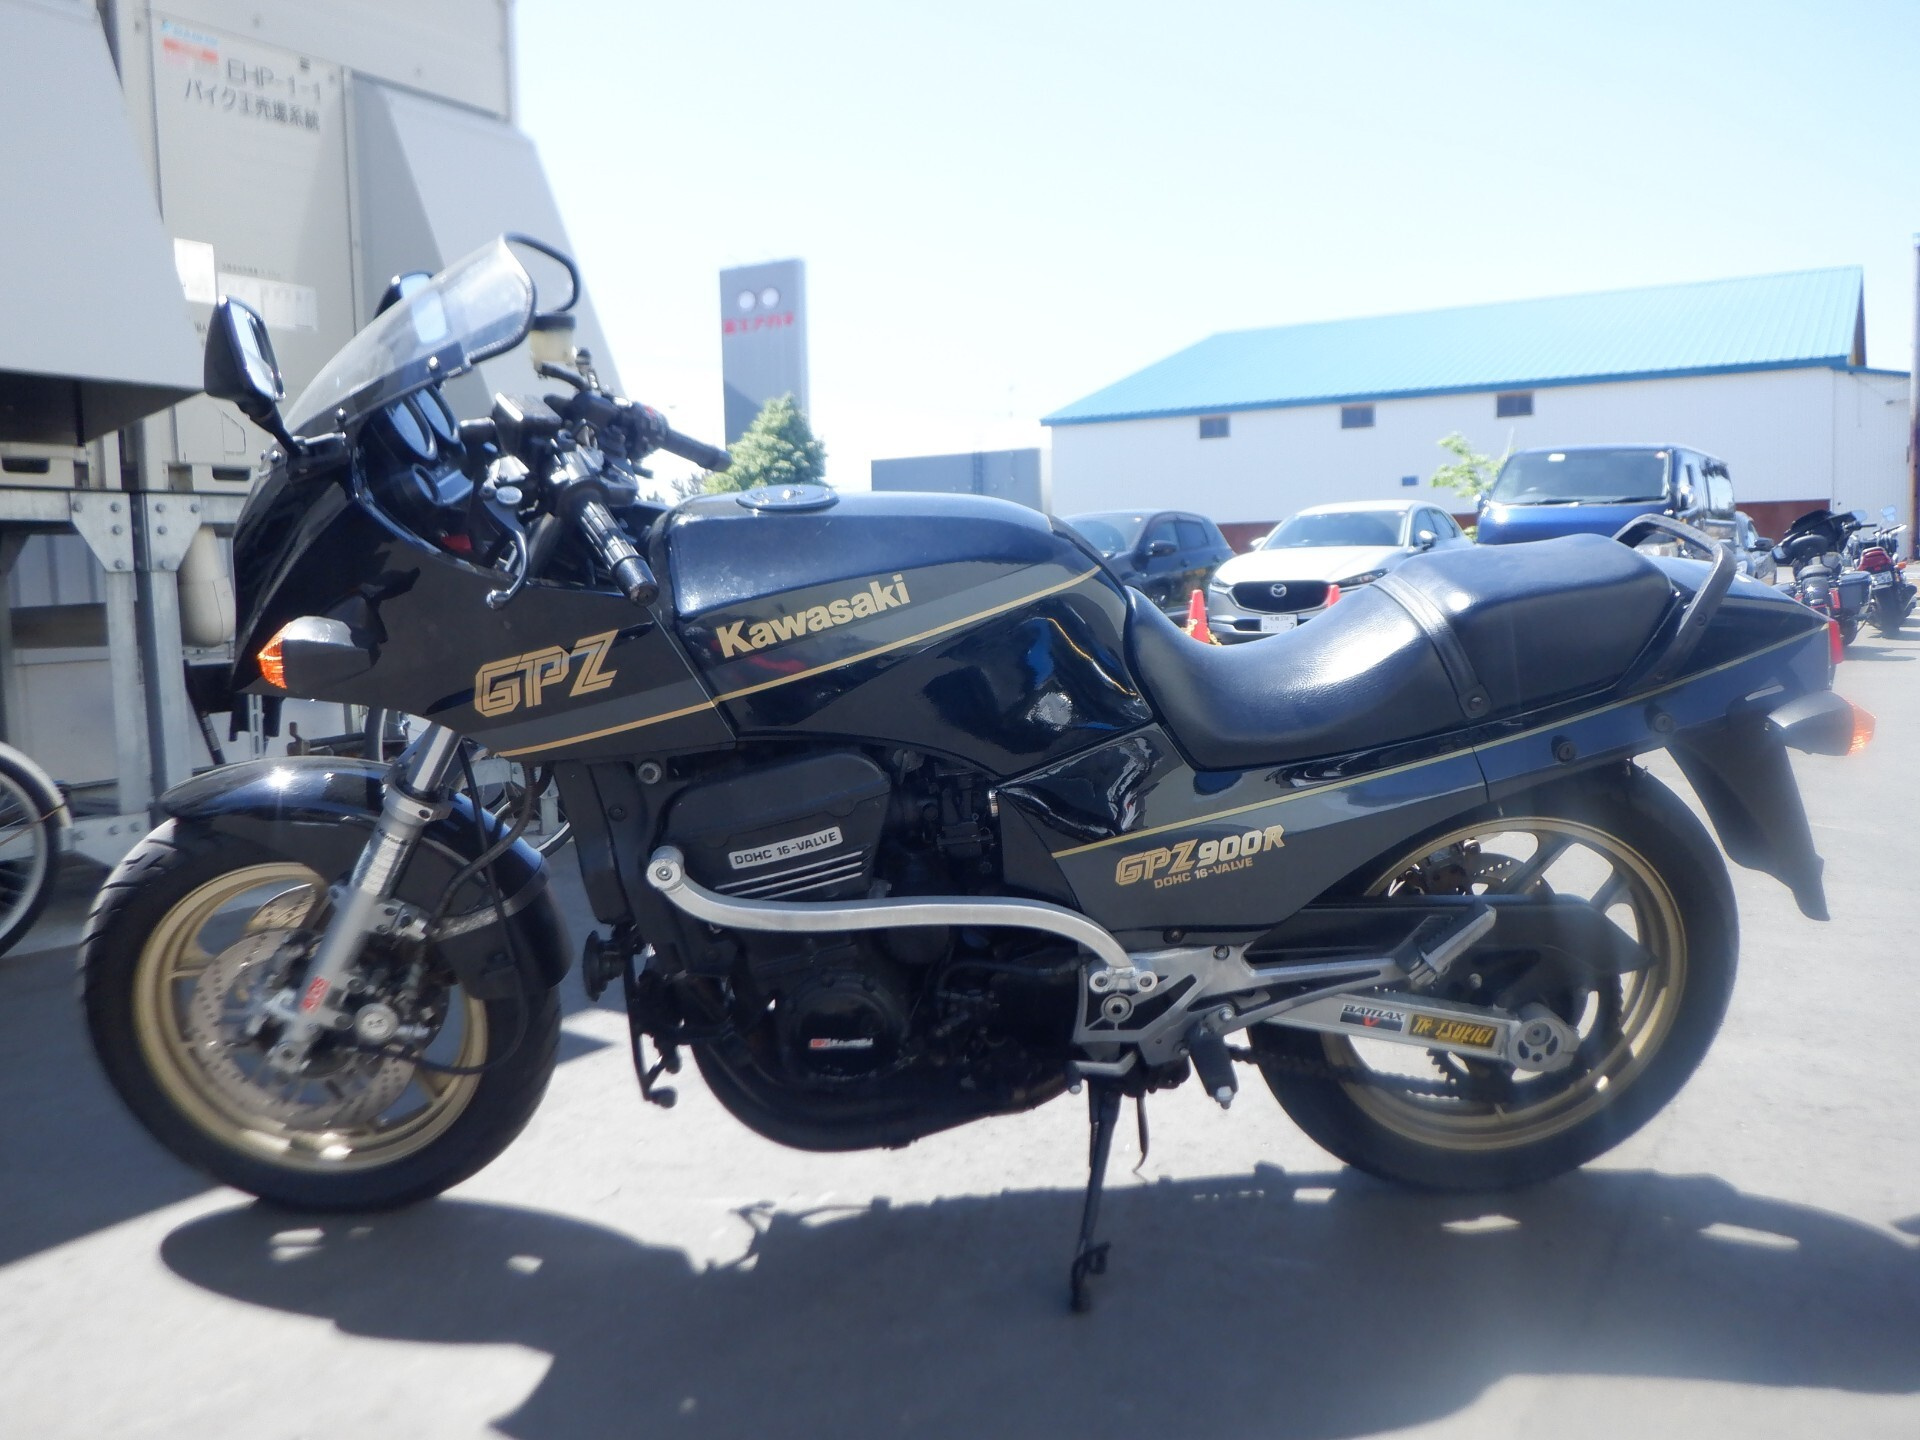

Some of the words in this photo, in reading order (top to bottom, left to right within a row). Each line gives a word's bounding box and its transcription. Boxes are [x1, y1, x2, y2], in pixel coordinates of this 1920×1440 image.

[716, 573, 911, 659] Kawasaki
[474, 629, 619, 718] GPZ
[734, 849, 773, 865] DOHC
[776, 832, 838, 857] 16-VALVE
[1154, 872, 1192, 889] DOHC
[1195, 857, 1254, 880] 16-VALVE
